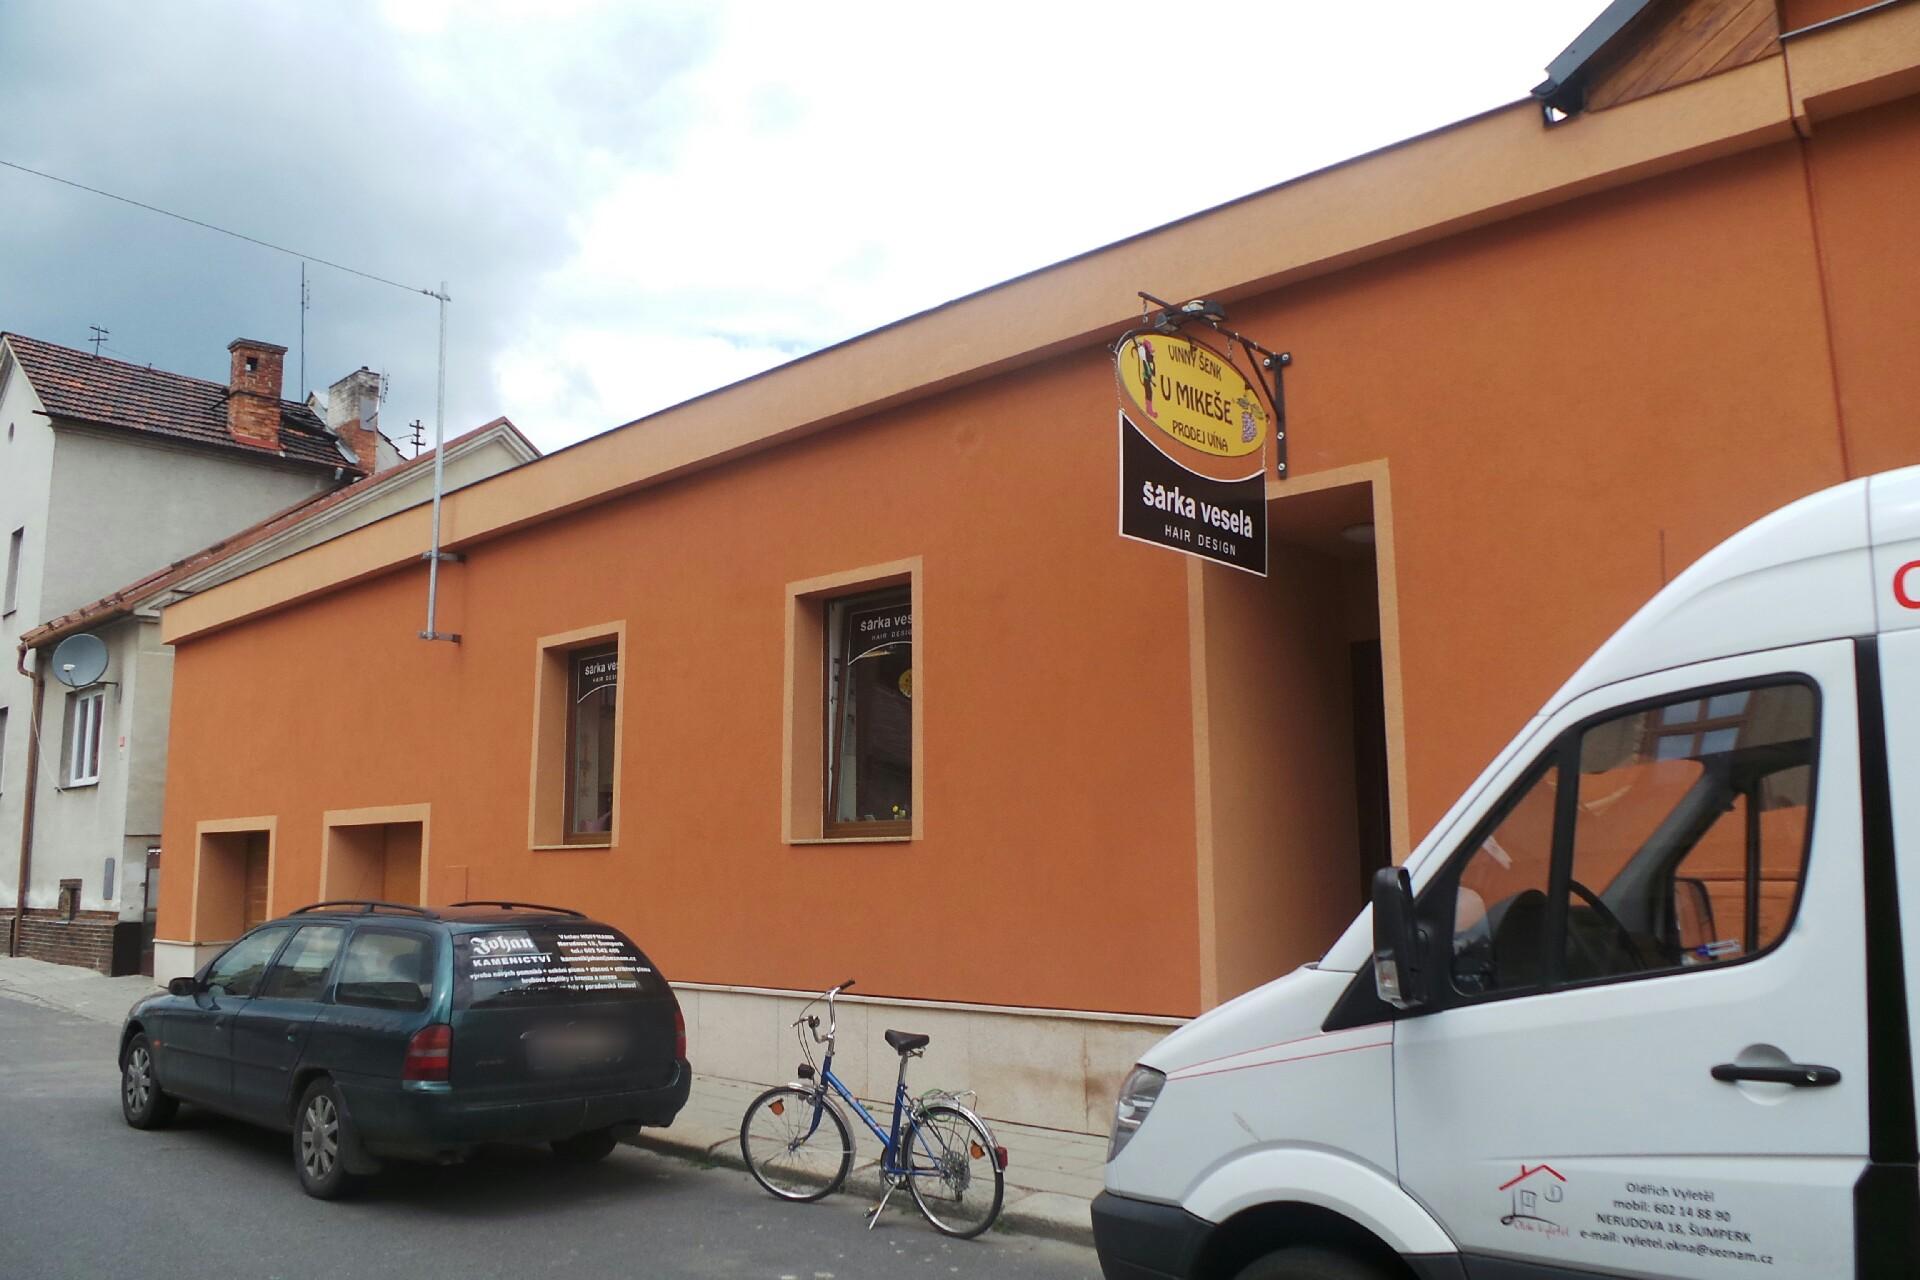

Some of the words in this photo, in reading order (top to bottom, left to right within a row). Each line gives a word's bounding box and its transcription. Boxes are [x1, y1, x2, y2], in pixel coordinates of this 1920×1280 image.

[1199, 351, 1222, 381] ŠENK
[1160, 374, 1171, 401] U
[1176, 381, 1233, 425] MIKEŠE
[1172, 420, 1205, 445] PRODEJ
[1164, 524, 1191, 543] HAIR
[1197, 534, 1236, 556] DESIGN
[470, 935, 534, 955] Johan
[472, 954, 552, 967] KAMENICTVÍ
[1625, 1182, 1670, 1197] Oldřich
[1613, 1200, 1651, 1213] mobil:
[1653, 1203, 1676, 1216] 602
[1679, 1205, 1694, 1217] 14
[1579, 1230, 1619, 1242] e-mail:
[1596, 1213, 1665, 1232] NERUDOVA
[1688, 1222, 1752, 1243] ŠUMPERK
